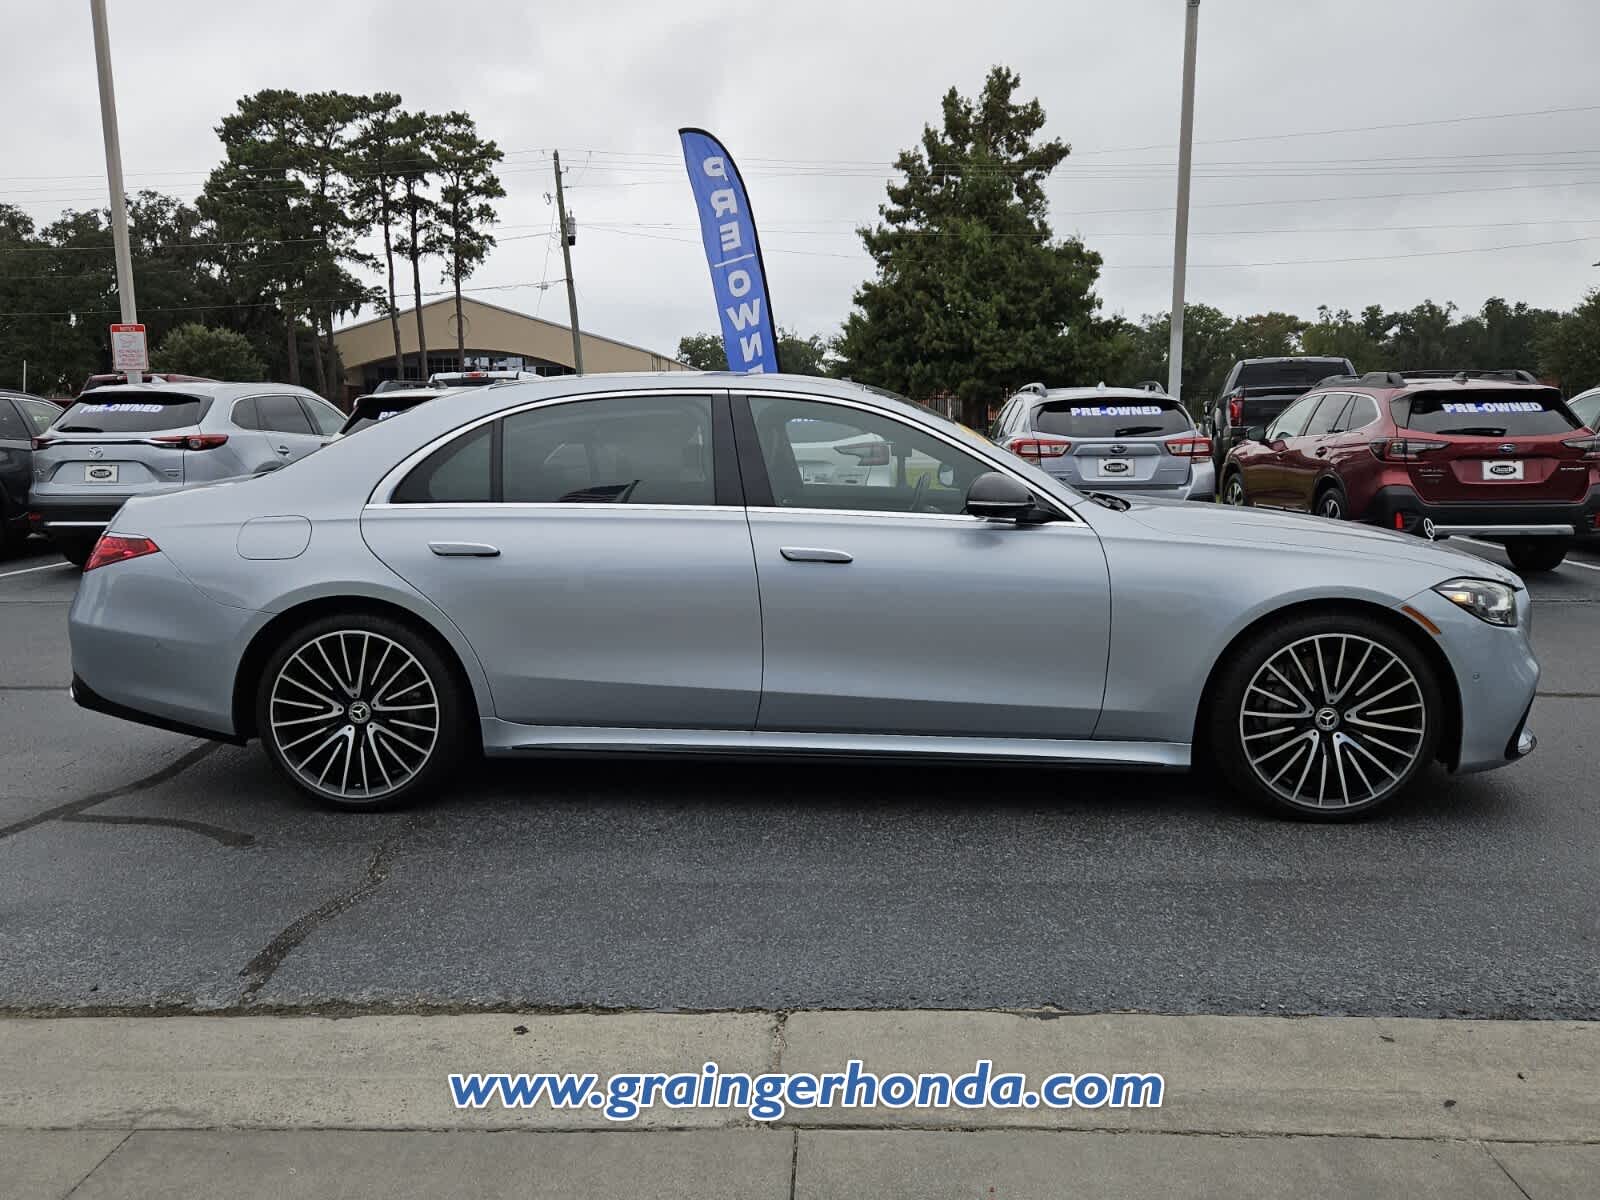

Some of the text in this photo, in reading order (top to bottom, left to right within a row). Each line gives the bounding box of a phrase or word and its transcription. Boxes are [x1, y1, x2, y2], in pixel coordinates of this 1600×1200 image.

[81, 404, 163, 414] PRE-OWNED
[1070, 406, 1162, 416] PRE-OWNED
[1441, 402, 1543, 413] PRE-OWNED
